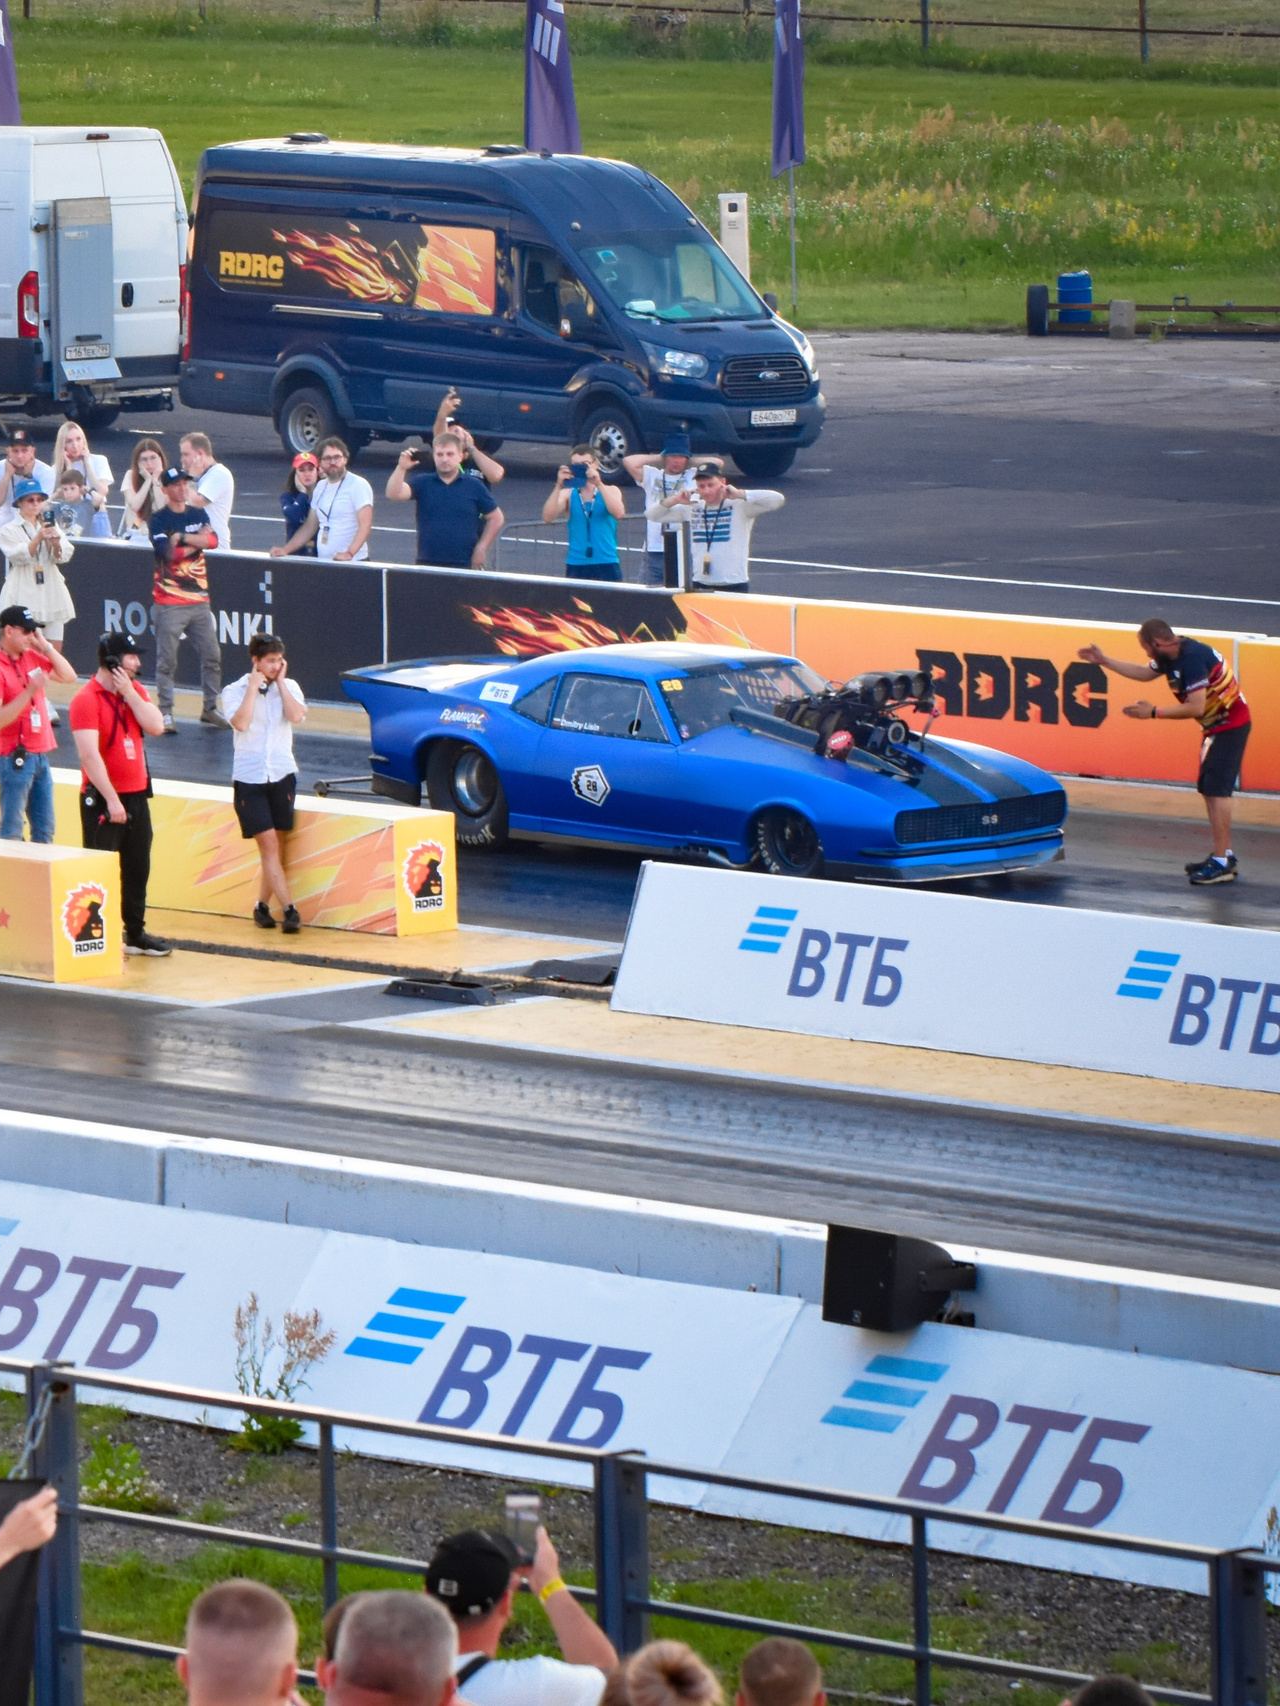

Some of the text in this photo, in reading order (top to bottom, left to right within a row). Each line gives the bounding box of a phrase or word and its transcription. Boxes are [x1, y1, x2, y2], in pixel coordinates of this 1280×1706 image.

[219, 251, 285, 280] RDRC
[915, 648, 1108, 729] RDRC
[560, 718, 584, 731] Dmitry
[587, 779, 598, 792] 28
[414, 897, 443, 910] RDRC
[74, 940, 105, 954] RDRC
[786, 927, 910, 1008] ВТБ
[1167, 973, 1280, 1056] ВТБ
[416, 1325, 653, 1450] ВТБ
[895, 1393, 1153, 1530] ВТБ
